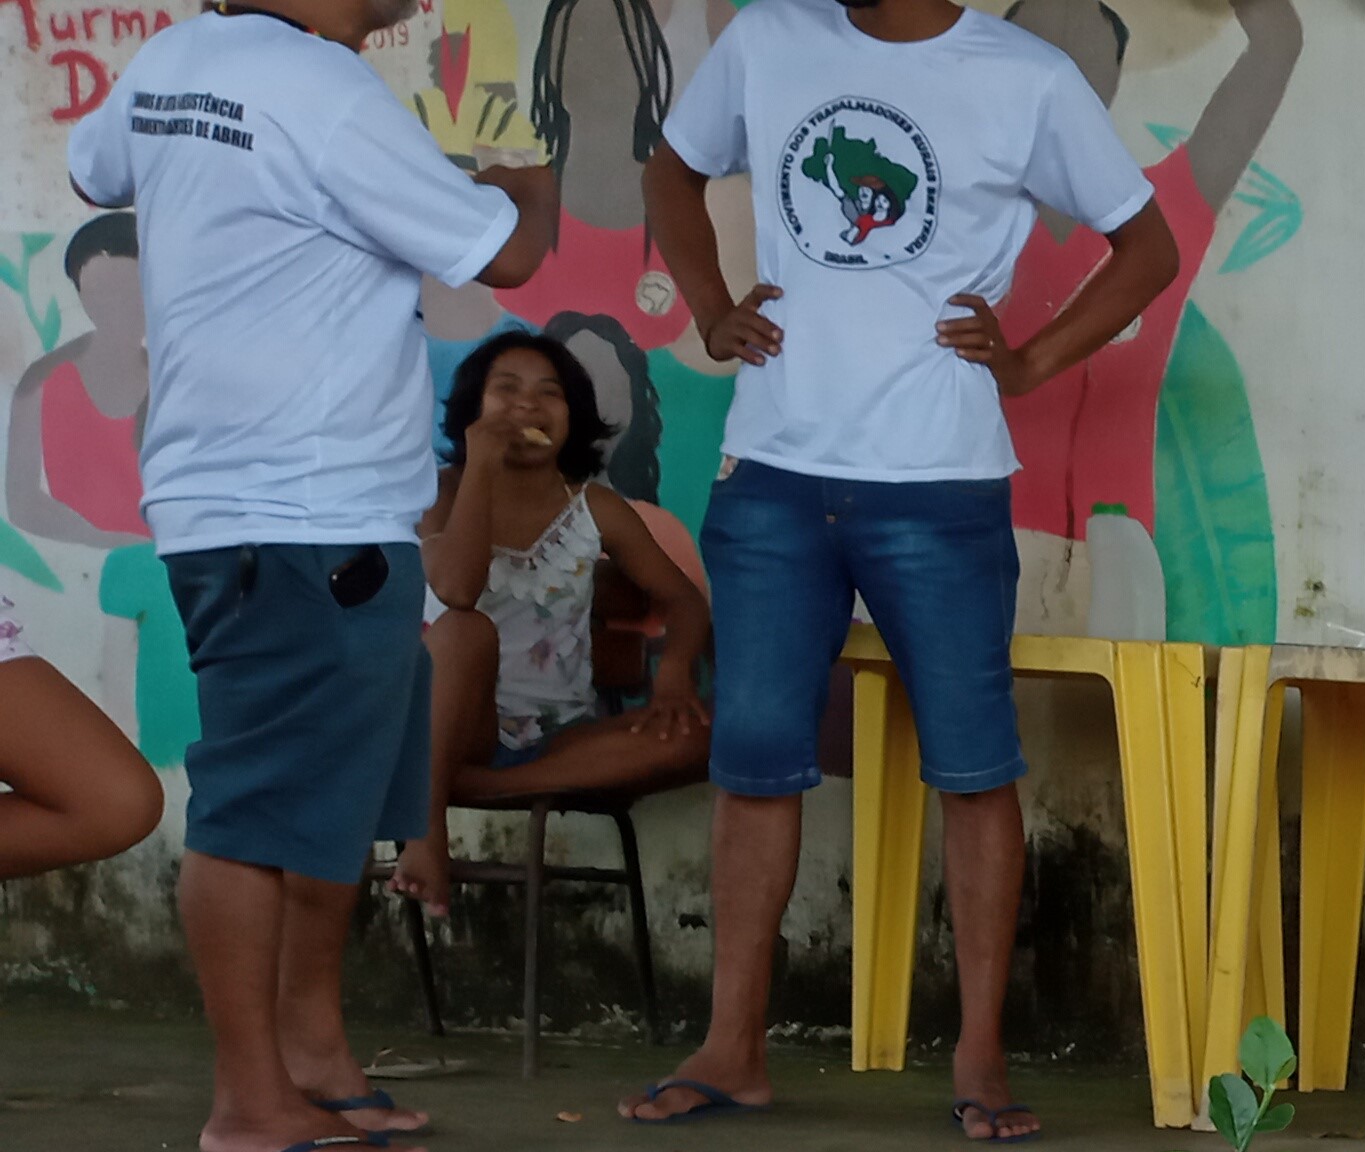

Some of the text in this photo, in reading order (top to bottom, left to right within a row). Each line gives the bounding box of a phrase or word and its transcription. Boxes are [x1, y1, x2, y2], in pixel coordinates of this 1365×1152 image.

[808, 99, 914, 134] TRABALHADORES
[211, 123, 254, 151] ABRIL
[791, 126, 810, 153] DOS
[910, 133, 937, 184] RURAIS
[780, 153, 804, 236] MOVIMENTO
[903, 217, 934, 255] TERRA
[823, 251, 869, 265] BRASIL
